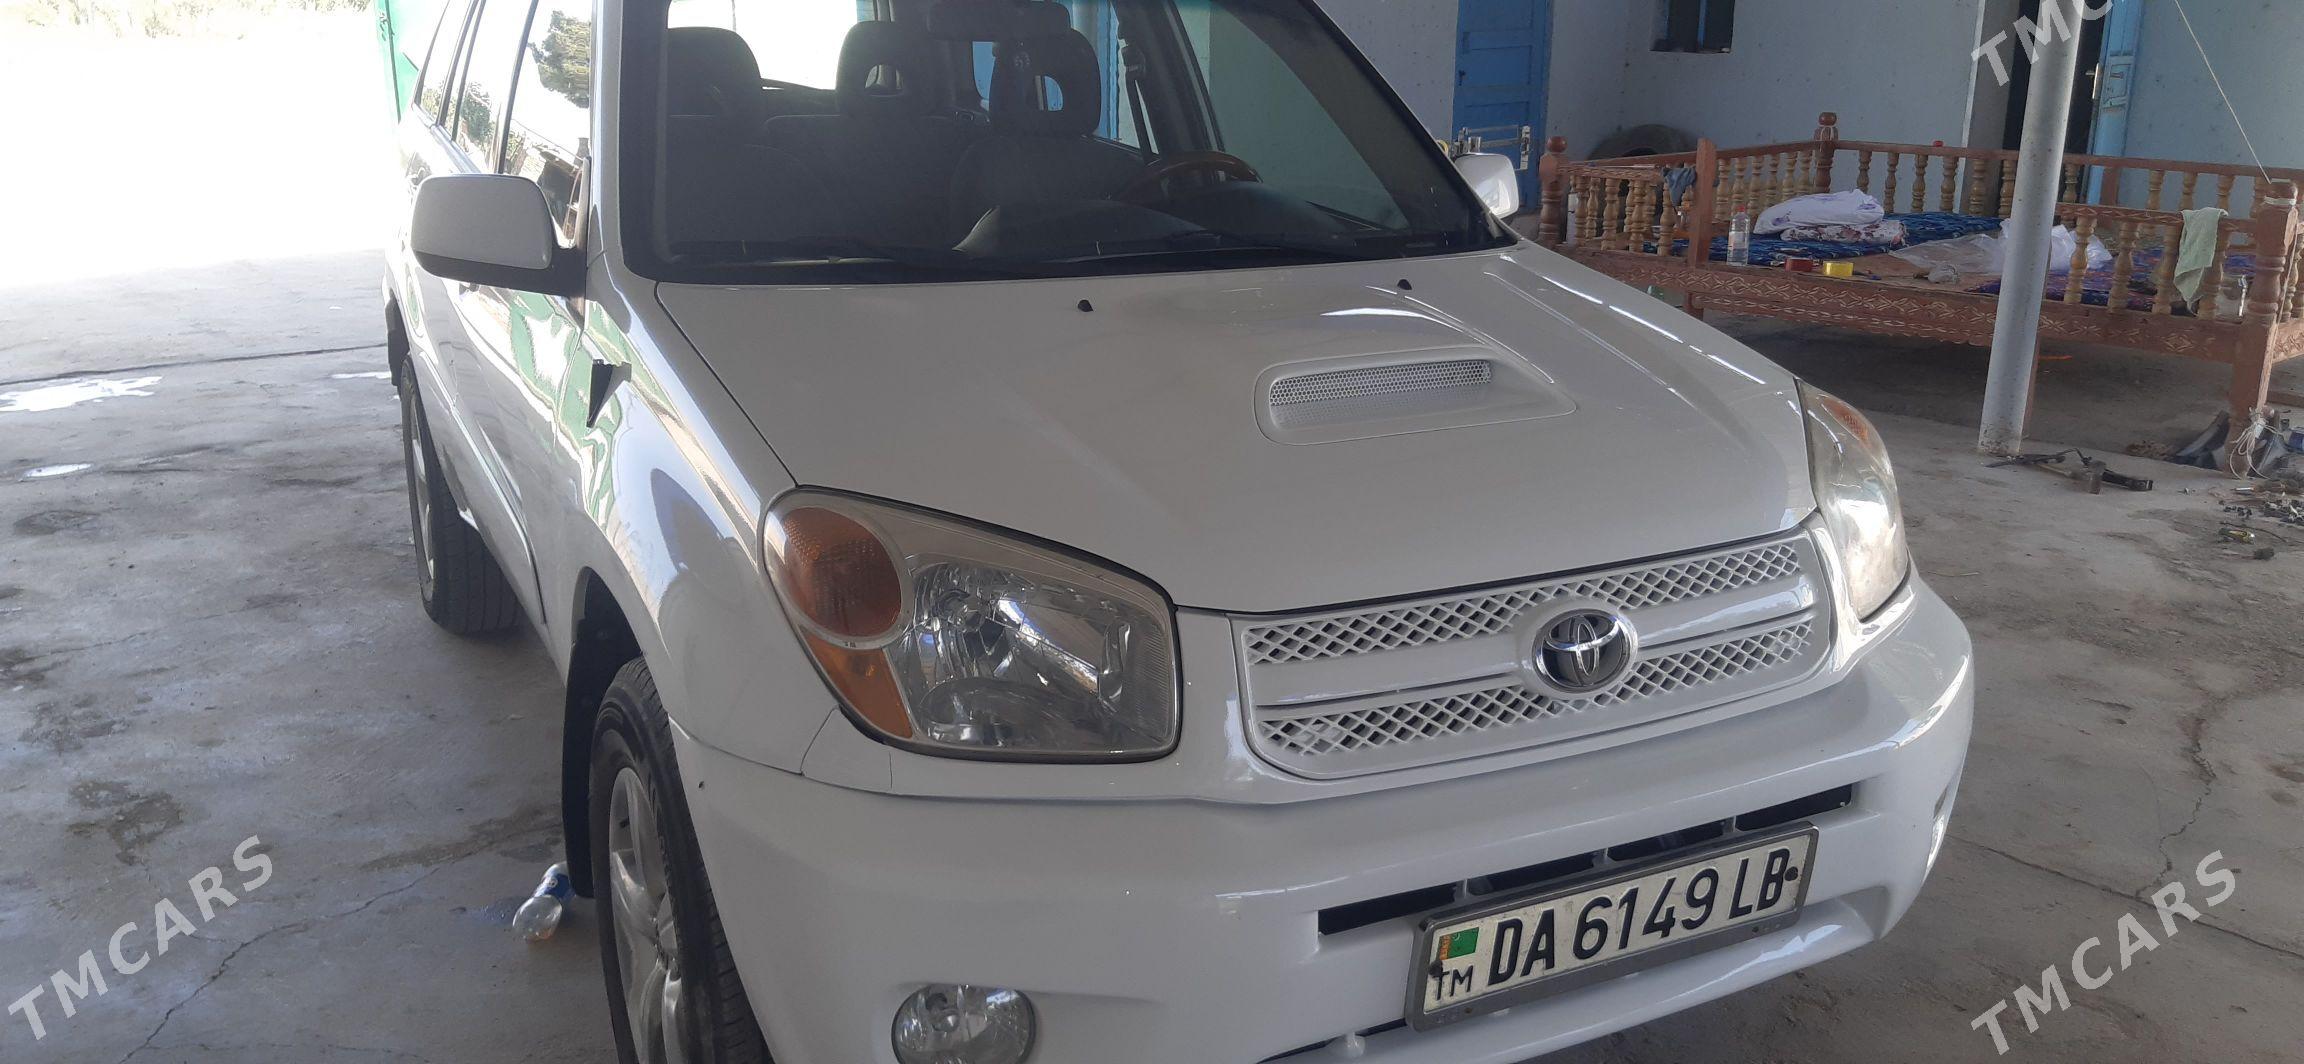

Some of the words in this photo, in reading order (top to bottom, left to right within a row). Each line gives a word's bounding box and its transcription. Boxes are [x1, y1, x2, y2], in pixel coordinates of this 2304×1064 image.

[1488, 908, 1555, 986] DA
[1572, 868, 1719, 960] 6149
[1728, 848, 1790, 920] LB
[1432, 965, 1473, 1000] TM
